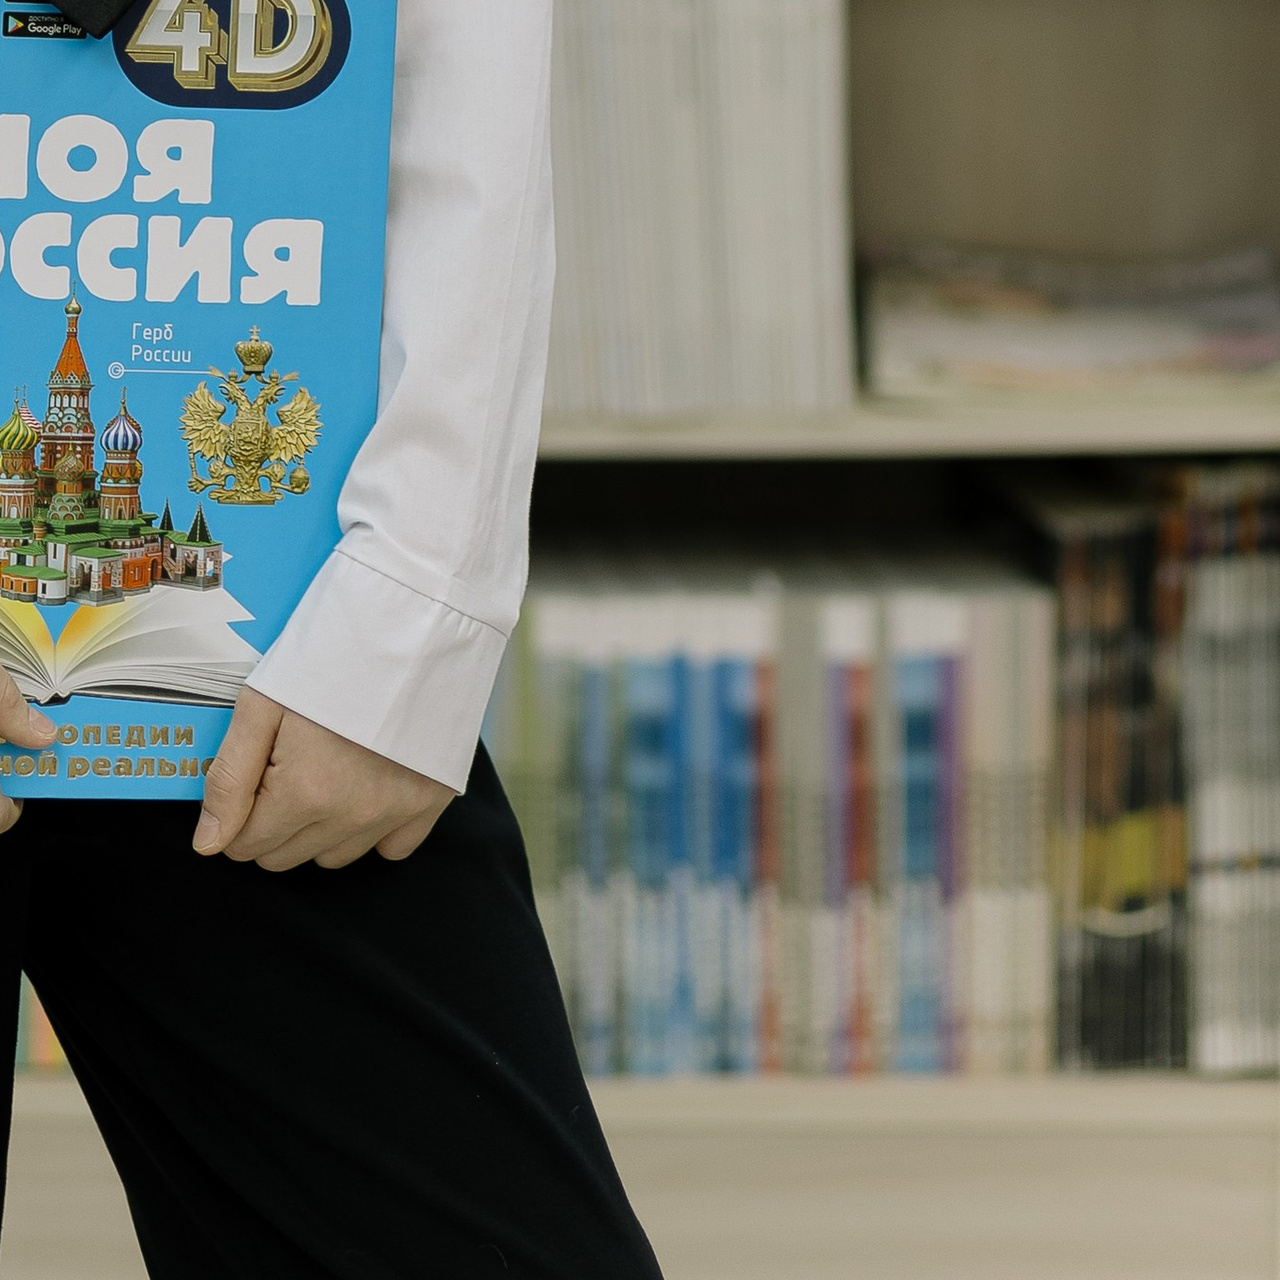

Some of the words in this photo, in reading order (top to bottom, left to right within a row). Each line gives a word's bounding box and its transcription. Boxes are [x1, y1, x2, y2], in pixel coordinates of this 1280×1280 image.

[27, 22, 61, 36] Google
[63, 23, 82, 36] Play
[132, 323, 173, 344] Герб
[131, 344, 192, 363] России
